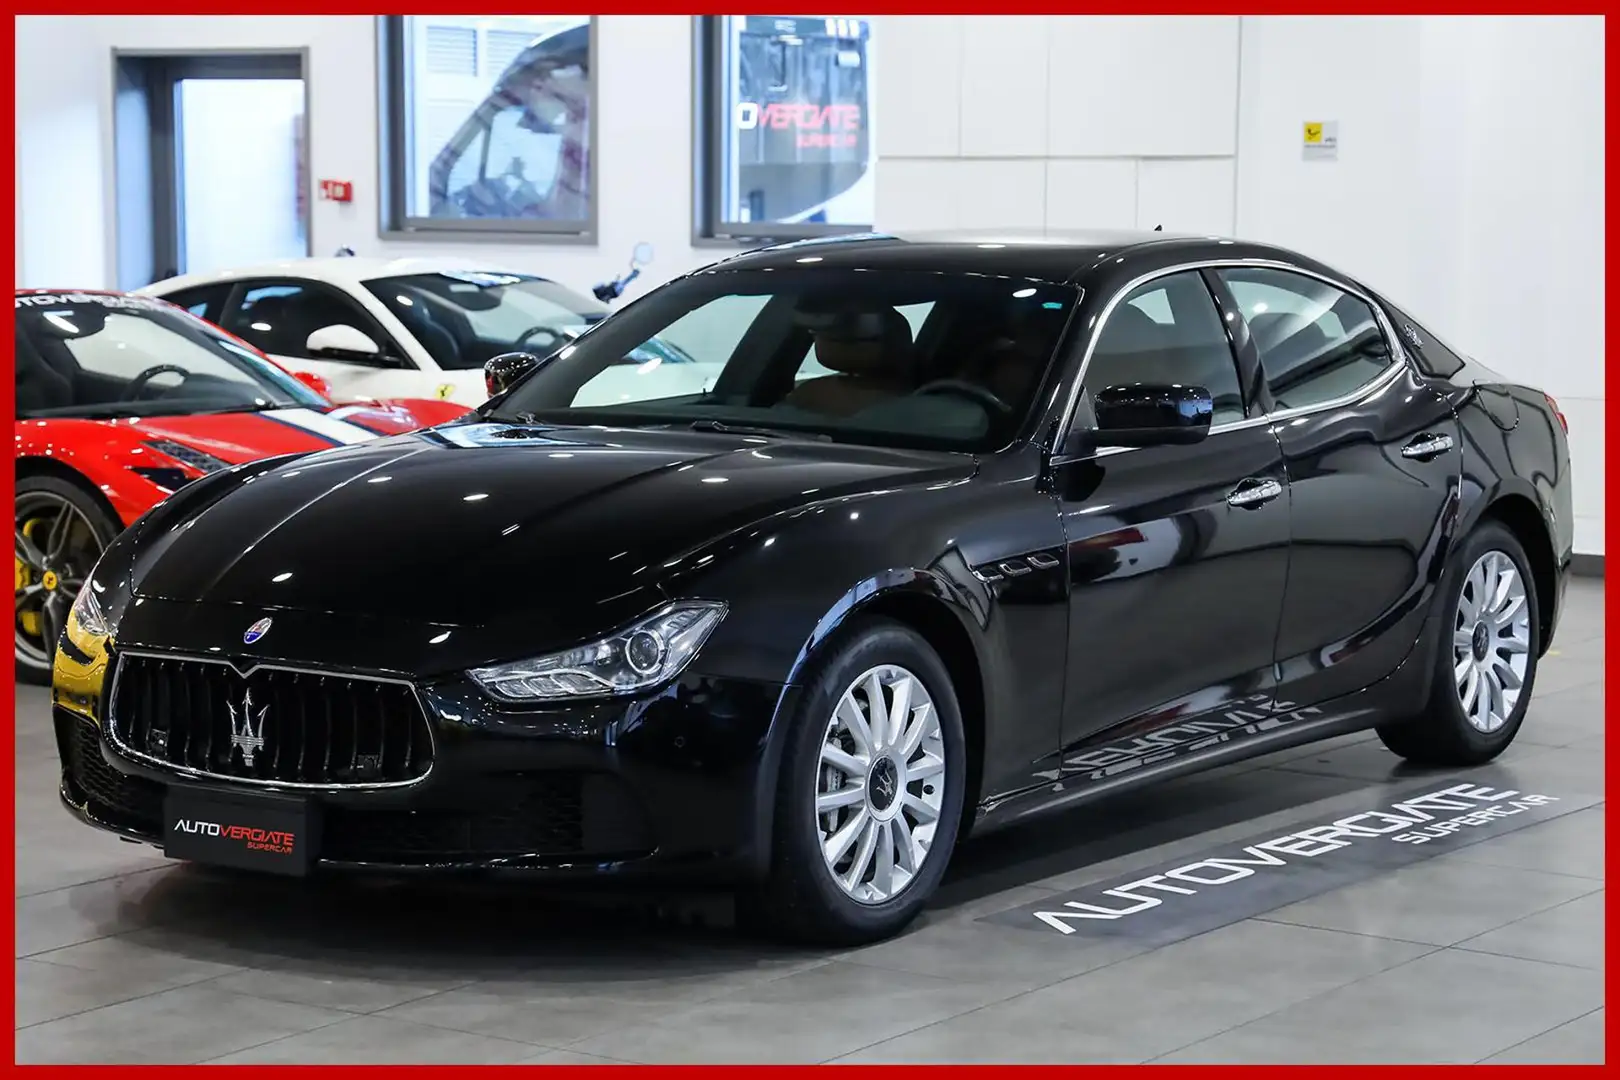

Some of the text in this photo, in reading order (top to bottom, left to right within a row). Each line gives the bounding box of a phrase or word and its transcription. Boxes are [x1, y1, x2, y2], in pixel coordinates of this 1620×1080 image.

[174, 819, 295, 846] AUTOVERGIATE
[1392, 793, 1560, 844] SUPERCAR
[247, 842, 293, 855] SUPERCAR
[1033, 782, 1520, 935] AUTOVERGIATE
